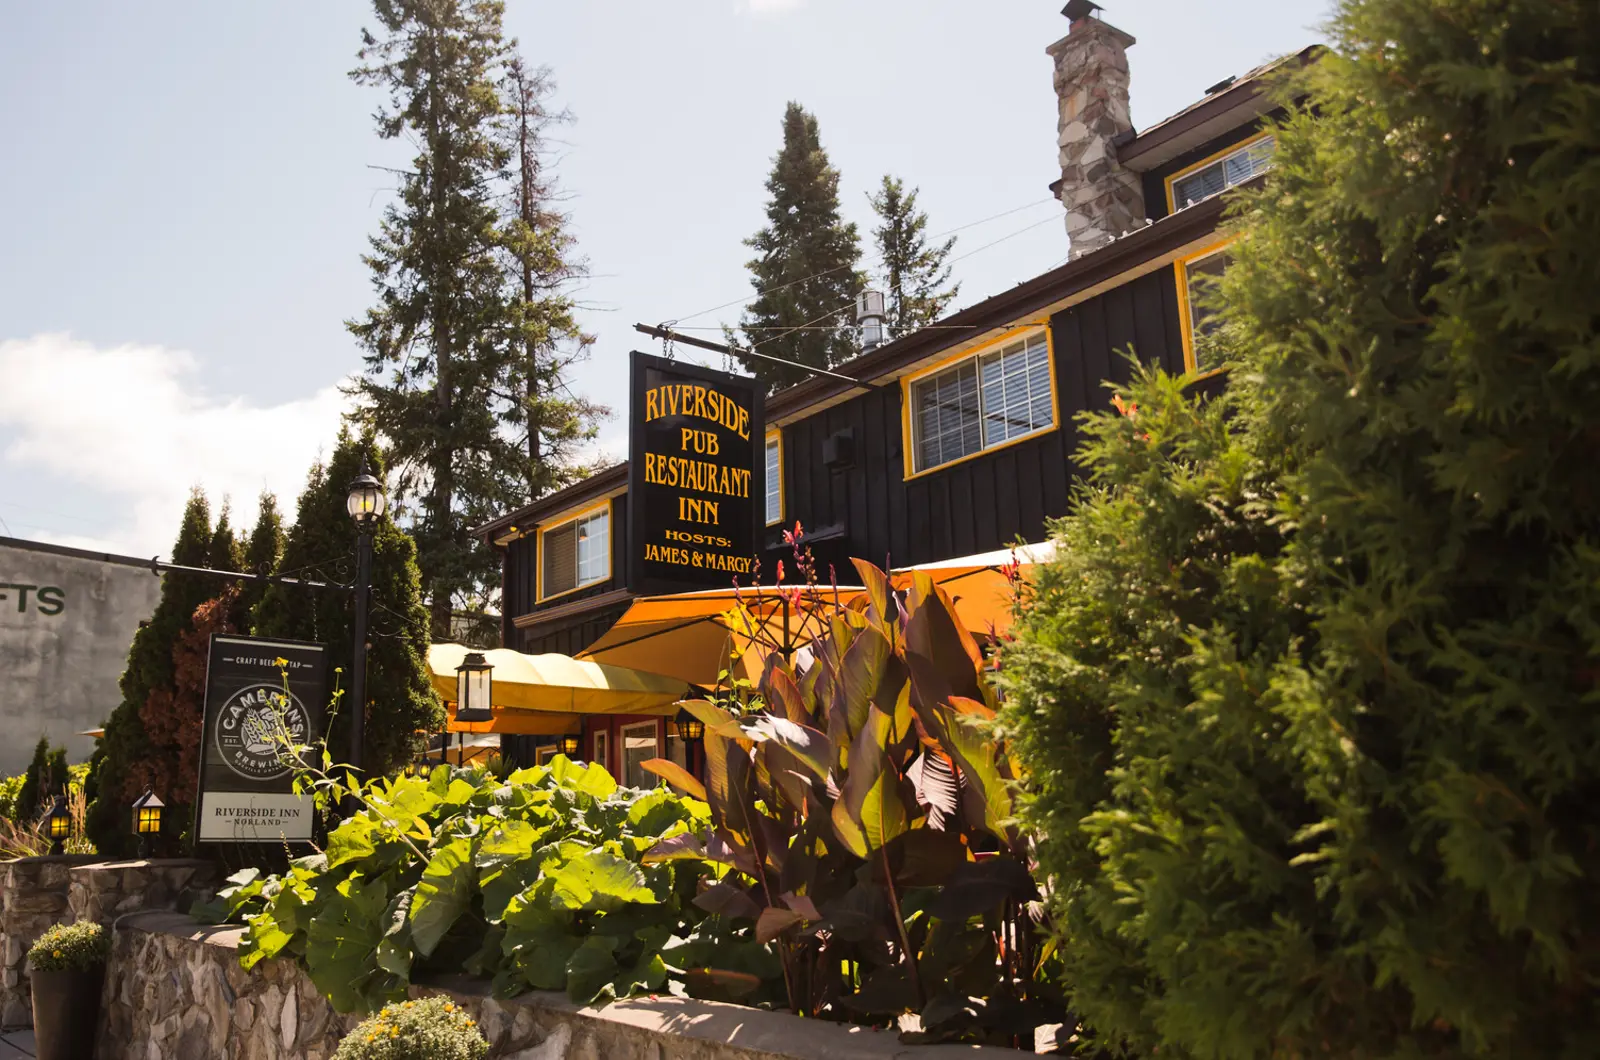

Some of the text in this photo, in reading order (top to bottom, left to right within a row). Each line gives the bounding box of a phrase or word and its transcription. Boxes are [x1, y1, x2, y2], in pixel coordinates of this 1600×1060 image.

[645, 384, 750, 442] RIVERSIDE
[681, 428, 720, 456] PUB
[644, 453, 751, 498] RESTAURANT
[678, 496, 720, 525] INN
[665, 529, 732, 548] HOSTS:
[644, 543, 752, 573] JAMES & MARGY
[235, 656, 257, 666] CRAFT
[289, 660, 302, 669] TAP
[235, 751, 290, 768] BREWIN
[215, 807, 300, 817] RIVERSIDE INN
[234, 818, 281, 826] NORLAND
